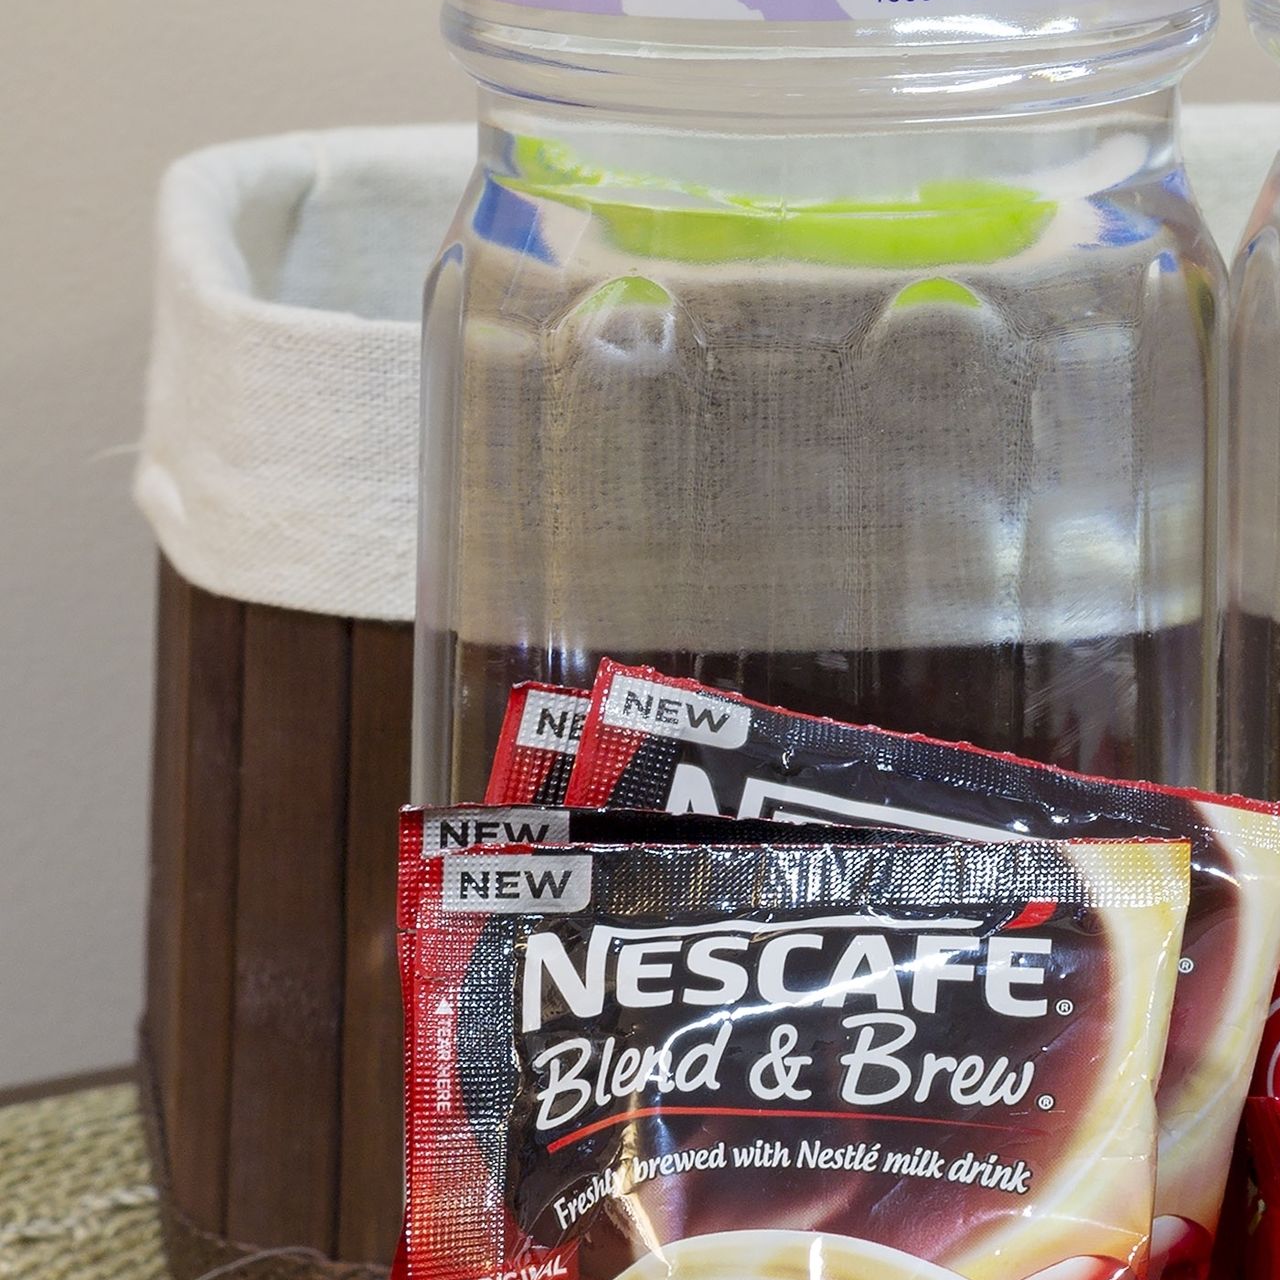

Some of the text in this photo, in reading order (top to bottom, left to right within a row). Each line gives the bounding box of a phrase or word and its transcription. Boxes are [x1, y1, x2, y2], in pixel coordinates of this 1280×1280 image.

[536, 708, 582, 740] NE
[622, 691, 731, 734] NEW
[439, 820, 550, 849] NEW
[459, 870, 573, 901] NEW
[436, 1066, 451, 1112] HERE
[534, 1014, 1035, 1131] Blend & Brew
[633, 1141, 728, 1182] brewed
[732, 1139, 791, 1170] with
[798, 1139, 880, 1171] Nestlé
[885, 1150, 944, 1179] milk
[947, 1152, 1032, 1195] drink
